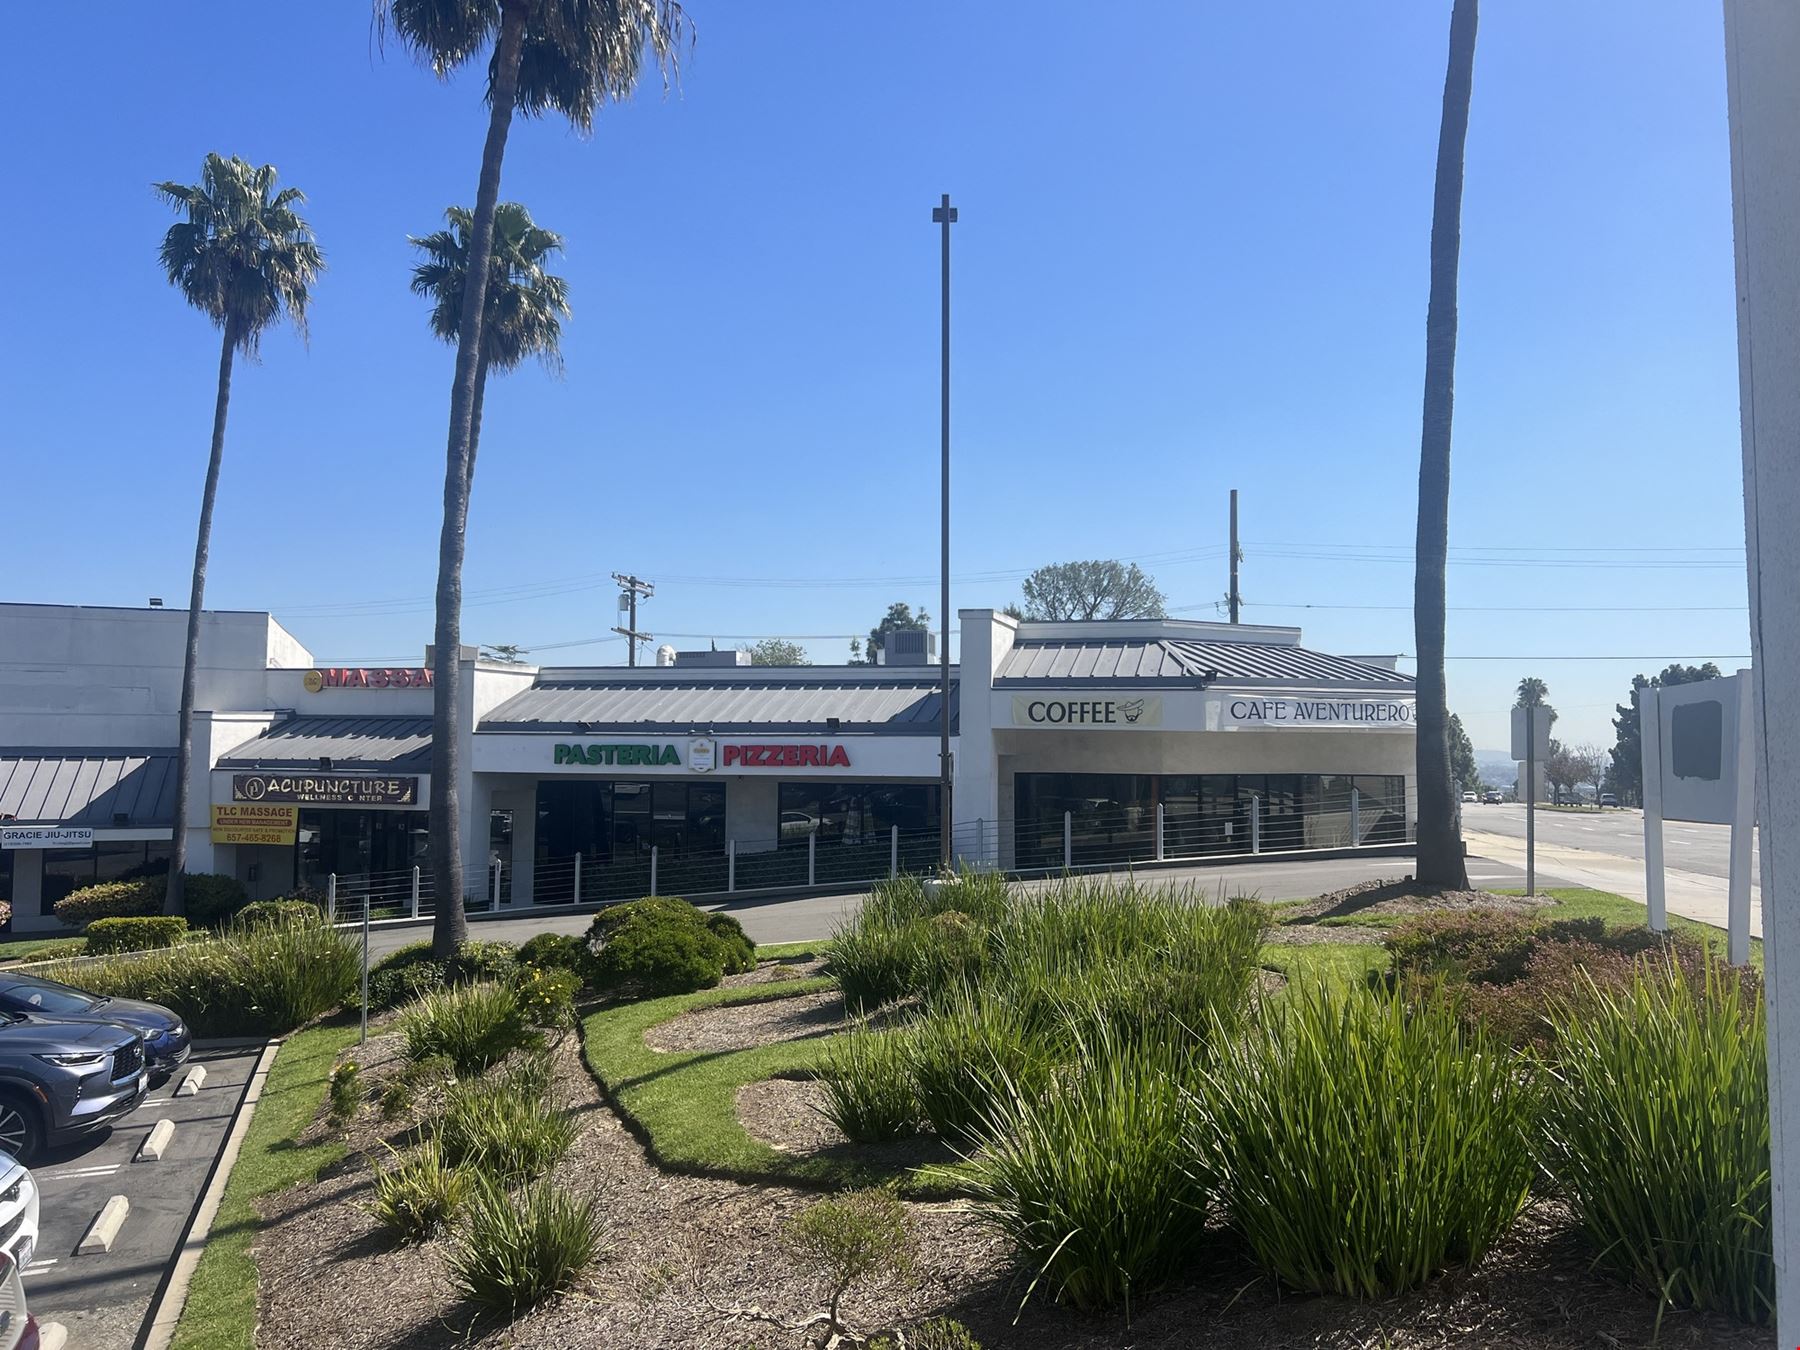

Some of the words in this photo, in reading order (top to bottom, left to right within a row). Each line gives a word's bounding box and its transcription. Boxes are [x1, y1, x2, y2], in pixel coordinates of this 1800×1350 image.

[321, 668, 434, 688] MASSA
[1028, 701, 1117, 724] COFFEE
[1230, 701, 1287, 720] CAFE
[1293, 702, 1410, 722] AVENTURERO
[554, 744, 681, 766] PASTERIA
[723, 745, 851, 767] PIZZERIA
[267, 778, 400, 795] ACUPUNCTURE
[297, 793, 342, 801] WELLNESS
[216, 806, 237, 816] TLC
[240, 807, 293, 817] MASSAGE
[3, 831, 42, 840] GRACIE
[44, 831, 92, 839] JIU-JITSU
[226, 833, 282, 843] 657-465-8268
